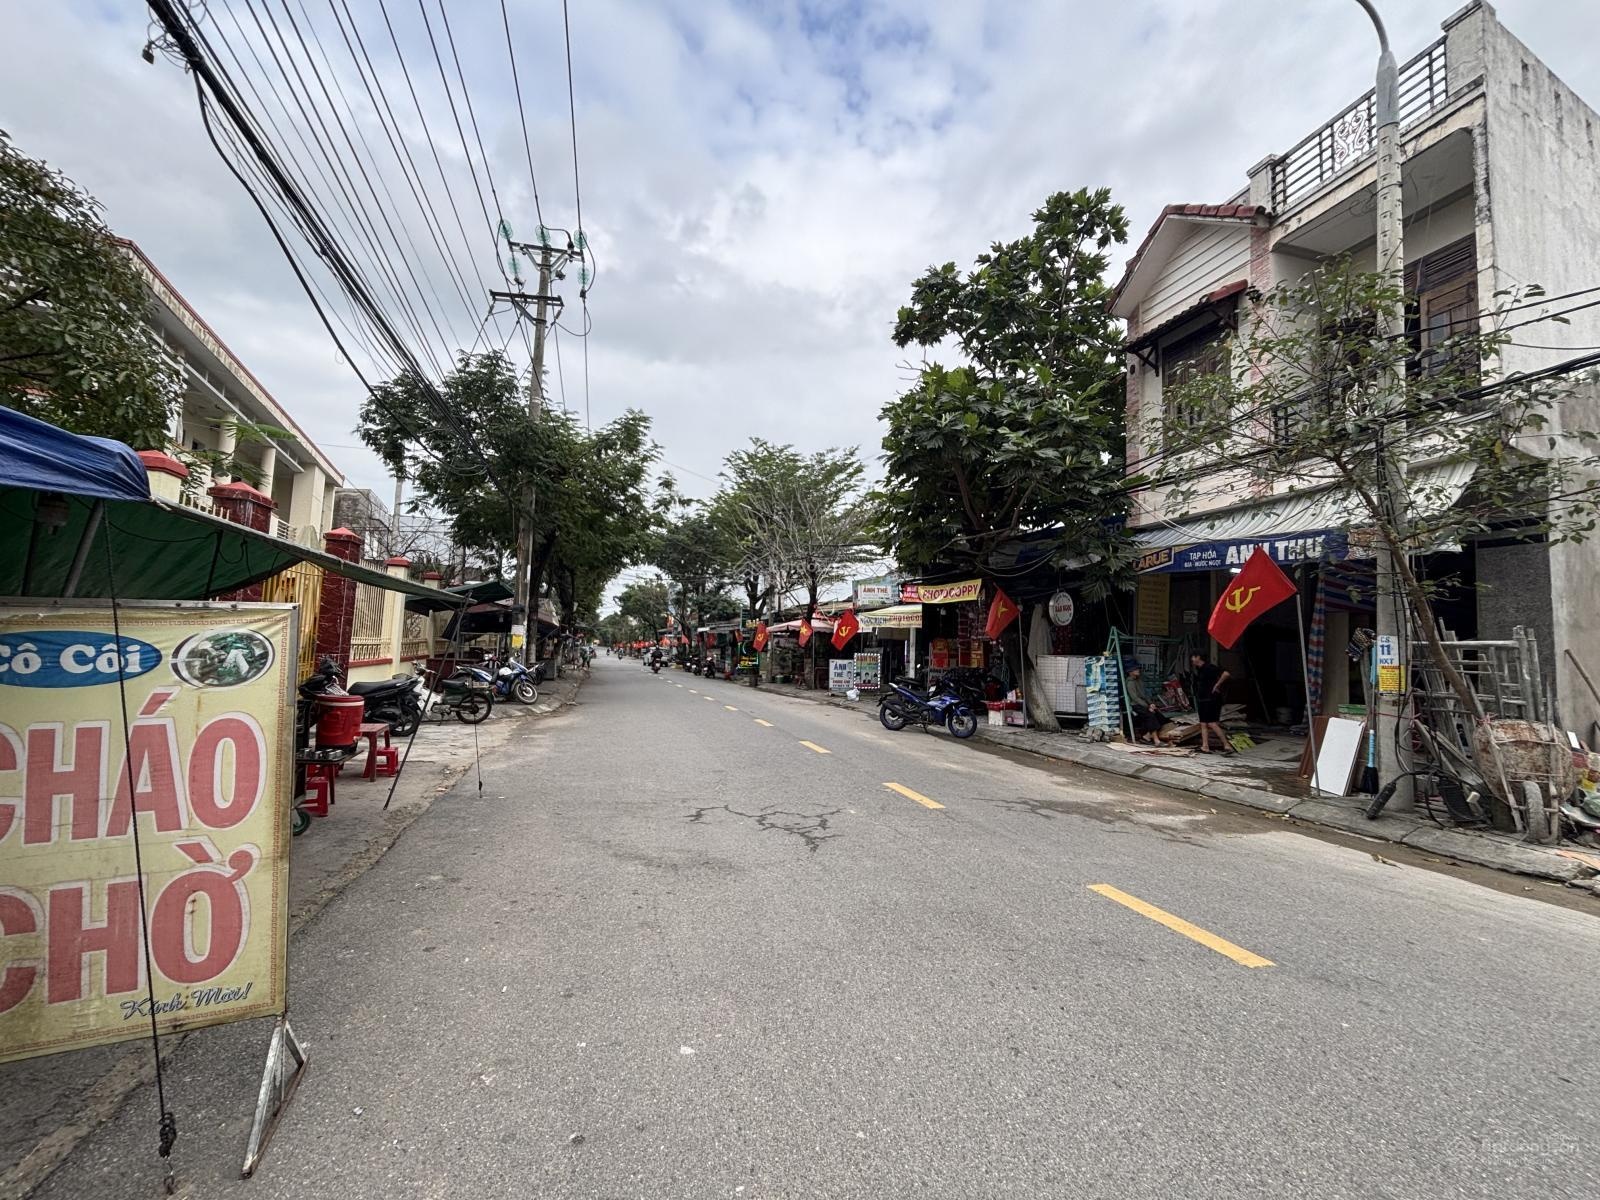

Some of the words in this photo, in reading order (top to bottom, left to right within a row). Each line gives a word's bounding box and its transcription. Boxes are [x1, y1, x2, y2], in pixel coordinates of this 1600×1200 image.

[1190, 552, 1202, 562] TẠP
[922, 584, 979, 600] PHOTOCOPPY
[1379, 644, 1391, 655] 11
[59, 643, 142, 674] Côi
